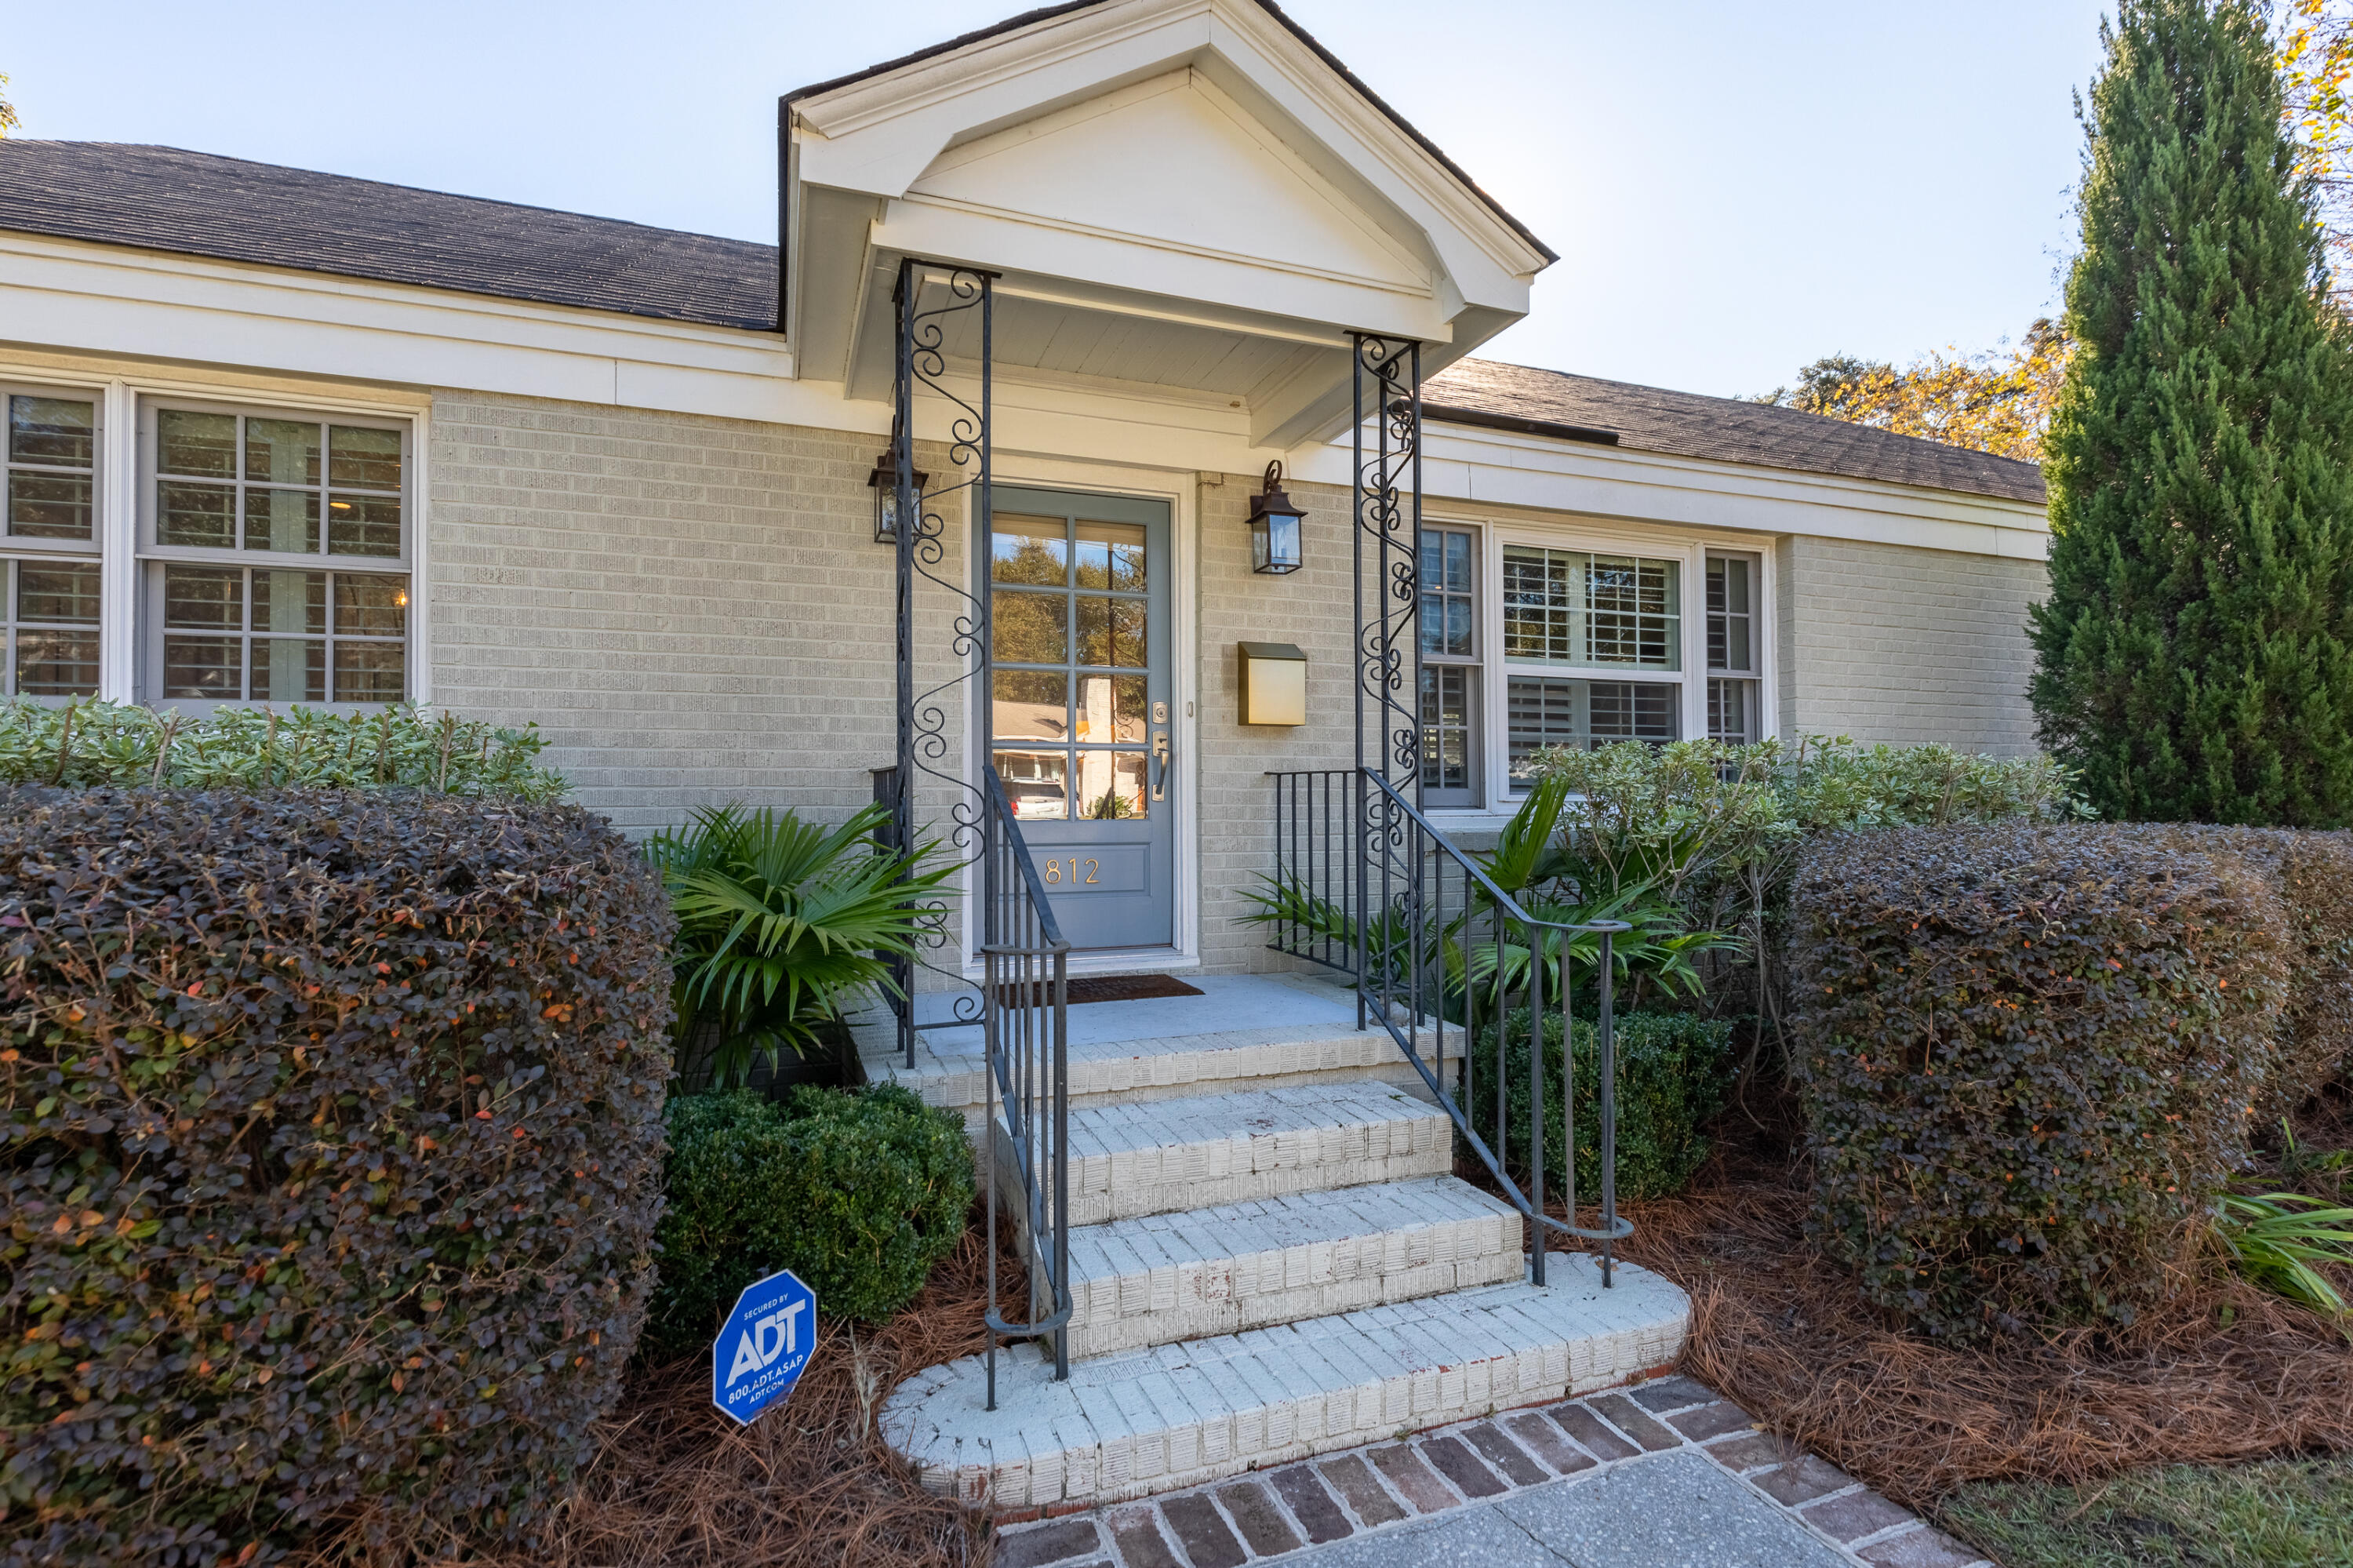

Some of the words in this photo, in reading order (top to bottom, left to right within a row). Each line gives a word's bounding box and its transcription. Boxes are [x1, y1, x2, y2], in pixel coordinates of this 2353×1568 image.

[1046, 858, 1100, 884] 812
[744, 1299, 778, 1321] SECURED
[779, 1293, 788, 1303] BY
[725, 1298, 806, 1389] ADT
[728, 1355, 803, 1404] 800.ADT.ASAP
